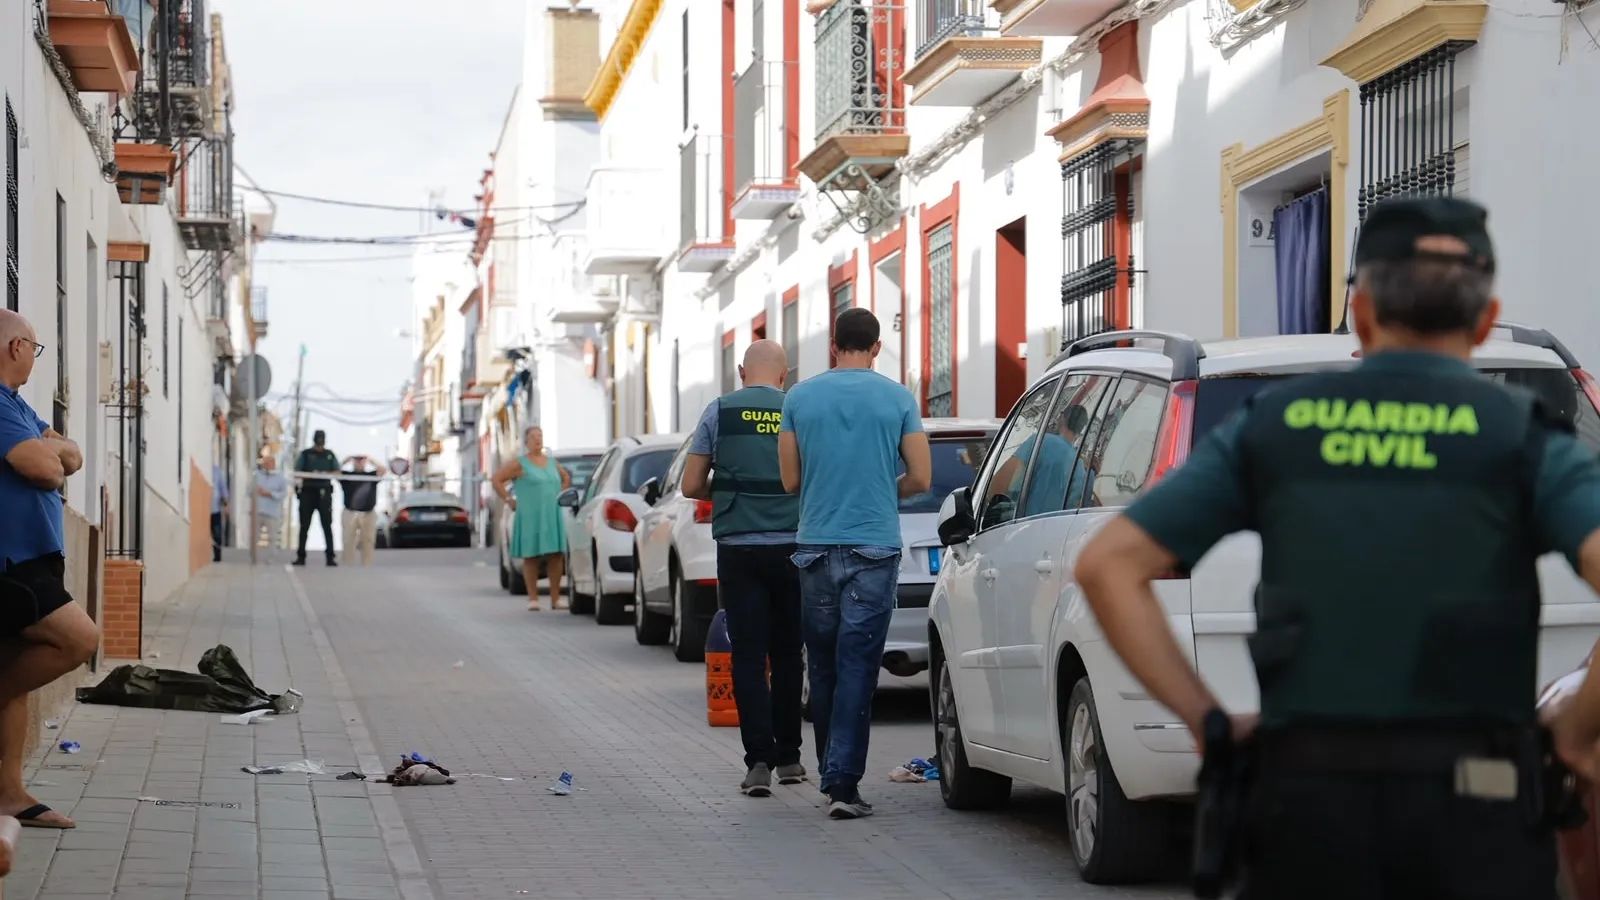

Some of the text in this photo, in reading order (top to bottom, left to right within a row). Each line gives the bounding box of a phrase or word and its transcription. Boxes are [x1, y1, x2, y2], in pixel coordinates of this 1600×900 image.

[1252, 219, 1263, 238] 9
[741, 410, 782, 422] GUAR
[1284, 398, 1479, 435] GUARDIA
[756, 423, 780, 433] CIV
[1320, 431, 1438, 469] CIVIL
